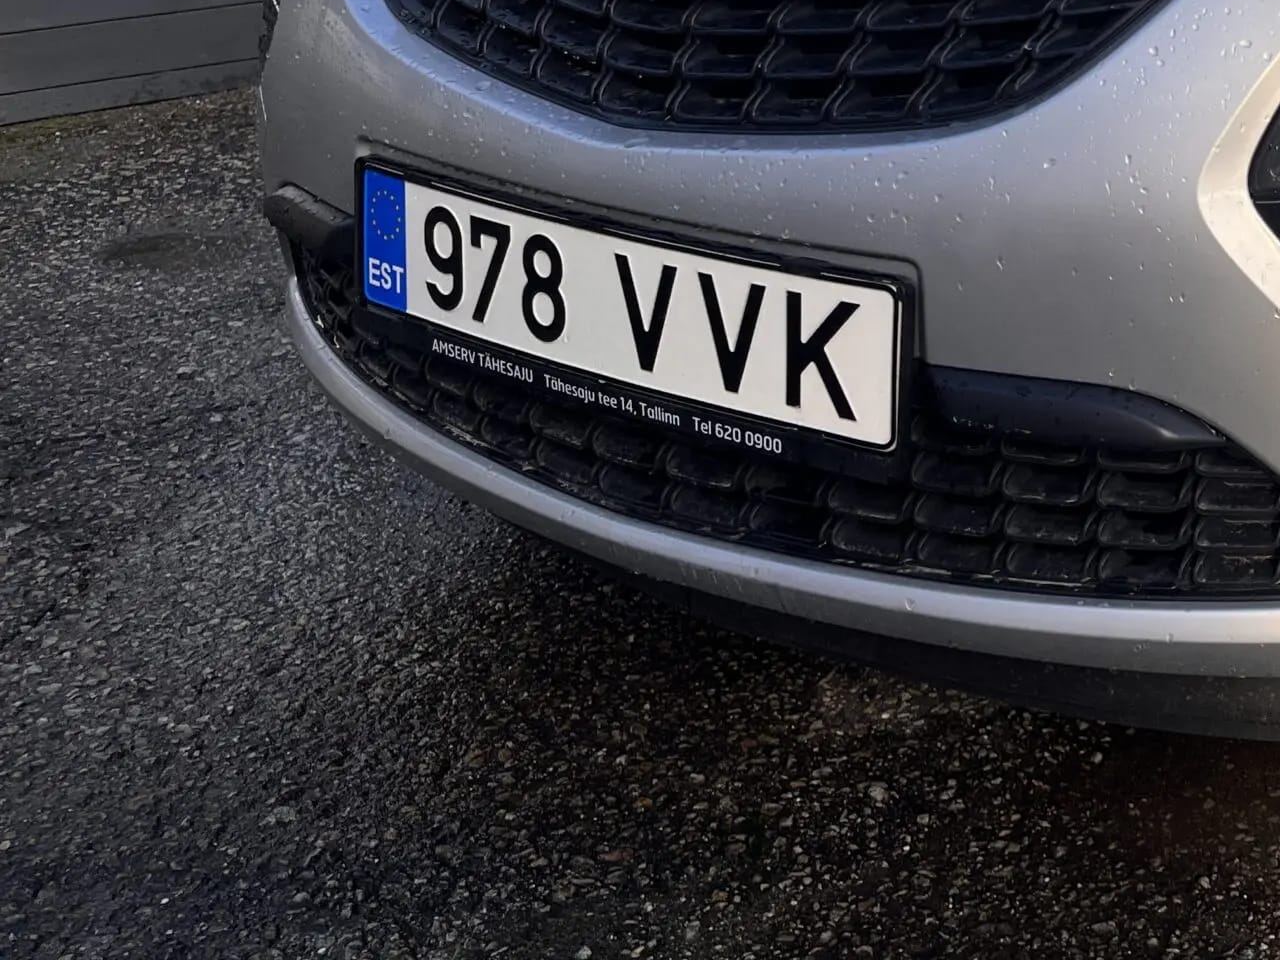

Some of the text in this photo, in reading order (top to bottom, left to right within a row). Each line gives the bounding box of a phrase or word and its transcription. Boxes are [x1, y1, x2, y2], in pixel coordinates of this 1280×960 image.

[368, 257, 404, 294] EST
[423, 206, 861, 422] 978 VVK
[432, 339, 783, 454] AMSERV TÄHESAJU Tähesaju tee 14, Tallinn Tel 620 0900
